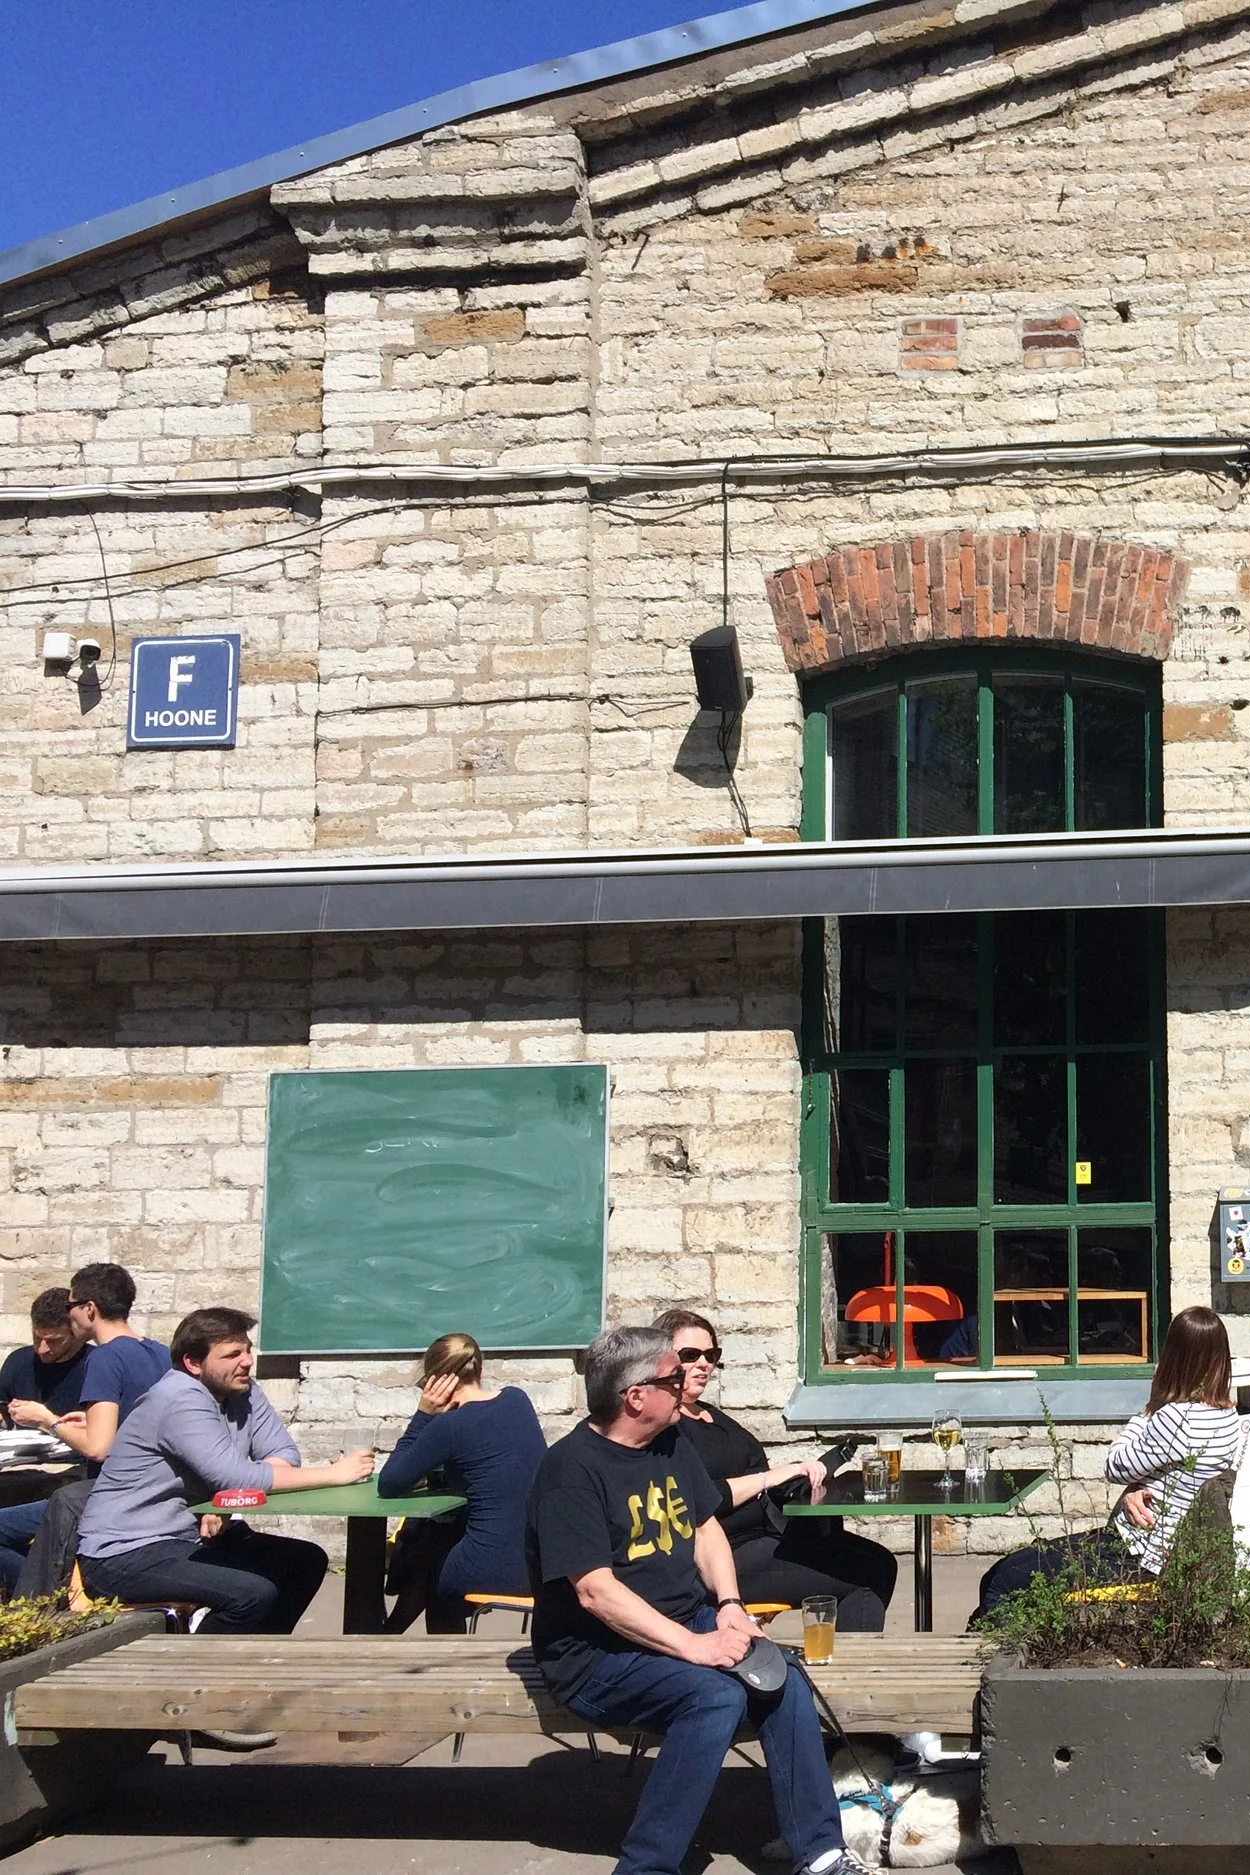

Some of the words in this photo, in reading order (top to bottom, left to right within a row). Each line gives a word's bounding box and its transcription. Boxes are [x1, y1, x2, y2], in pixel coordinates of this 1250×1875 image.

[167, 655, 196, 702] F
[145, 709, 217, 727] HOONE
[220, 1495, 259, 1507] TUBORG
